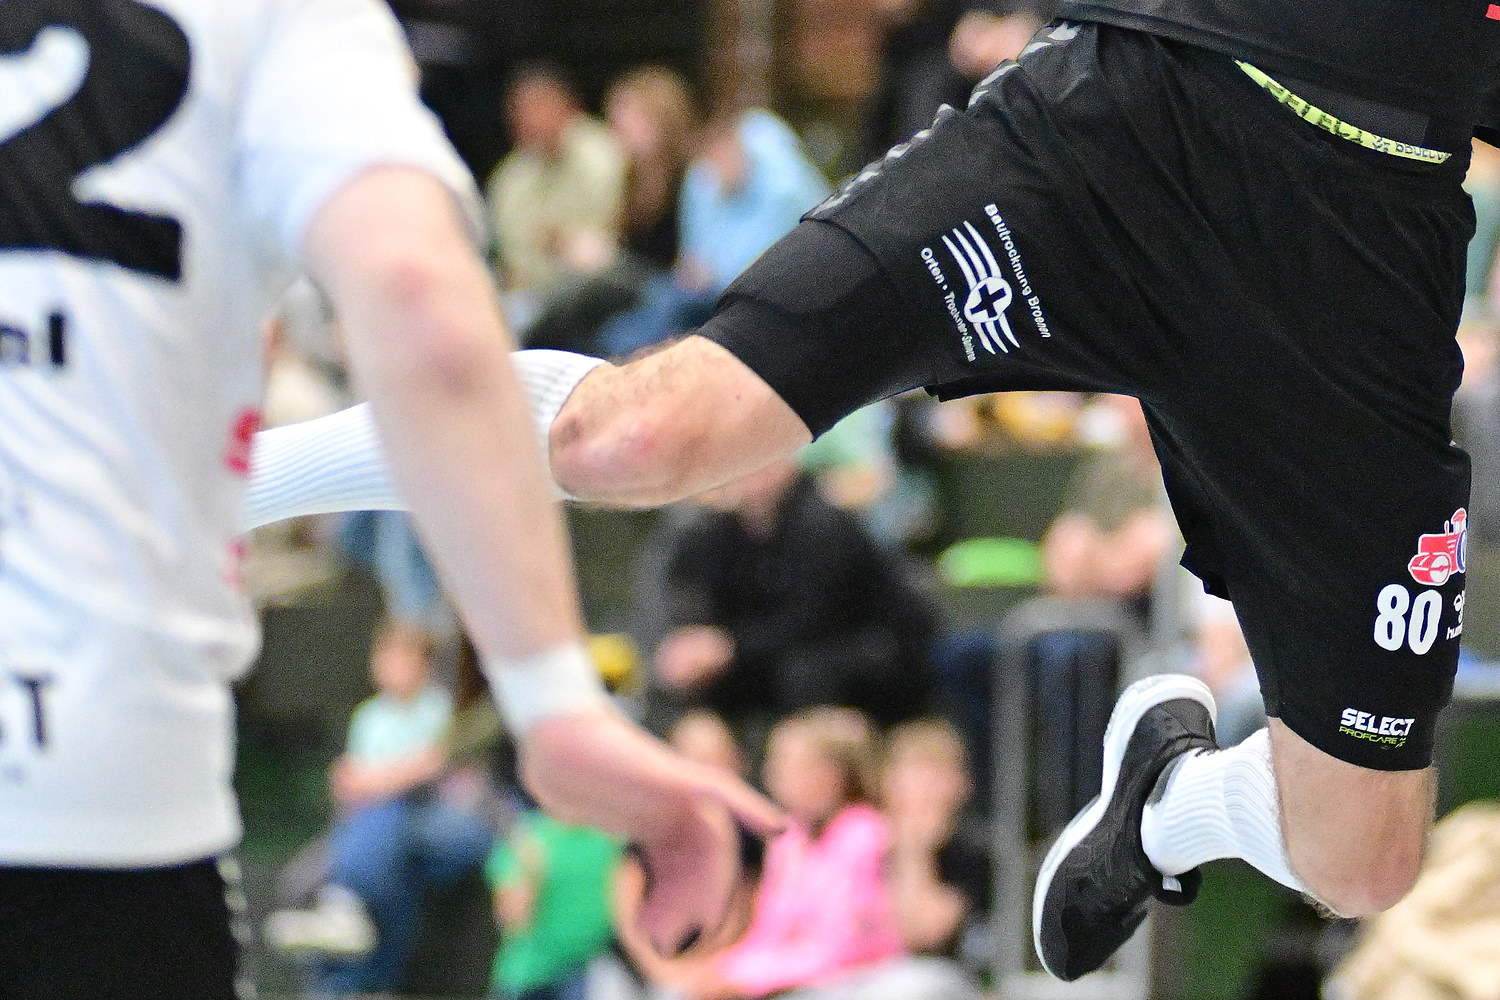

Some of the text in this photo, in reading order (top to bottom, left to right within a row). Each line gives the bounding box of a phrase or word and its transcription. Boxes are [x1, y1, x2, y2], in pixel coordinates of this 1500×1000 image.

[920, 247, 946, 285] Orten
[983, 203, 1033, 296] Bautrocknung
[1373, 583, 1443, 656] 80
[1340, 707, 1416, 737] SELECT
